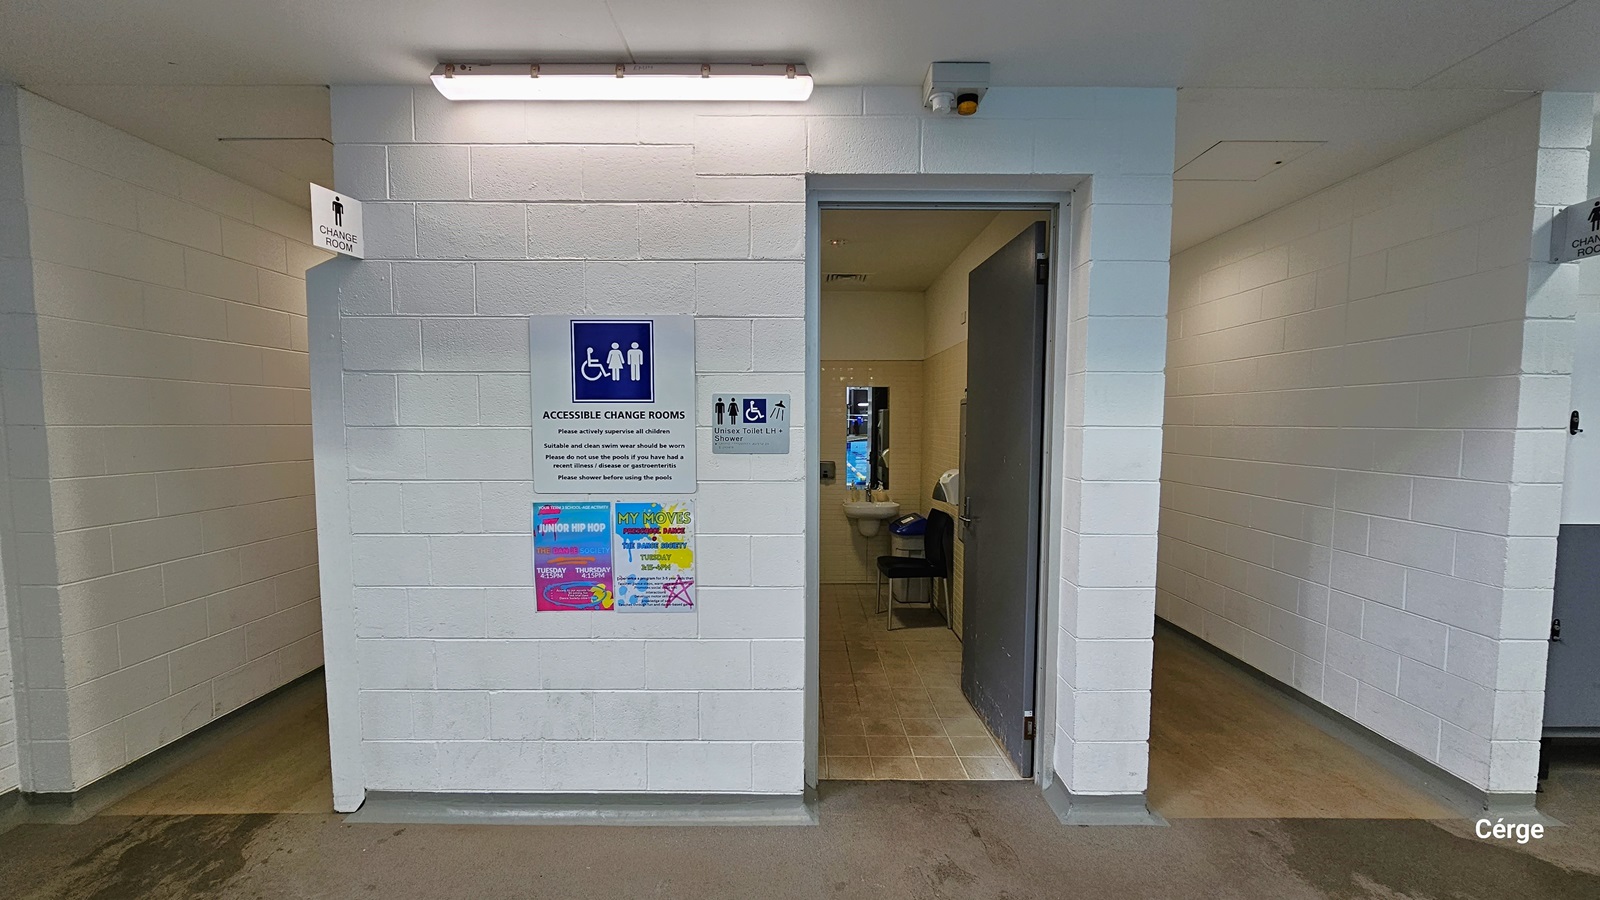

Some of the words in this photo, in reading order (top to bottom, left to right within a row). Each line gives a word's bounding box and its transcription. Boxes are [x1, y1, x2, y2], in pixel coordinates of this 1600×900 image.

[320, 225, 358, 244] CHANGE
[326, 237, 353, 252] ROOM
[542, 410, 601, 420] ACCESSIBLE
[604, 410, 646, 420] CHANGE
[648, 410, 686, 420] ROOMS
[618, 512, 639, 524] MY
[643, 512, 691, 524] MOVES
[539, 524, 569, 532] JUNIOR
[572, 524, 586, 532] HIP
[588, 523, 606, 532] HOP
